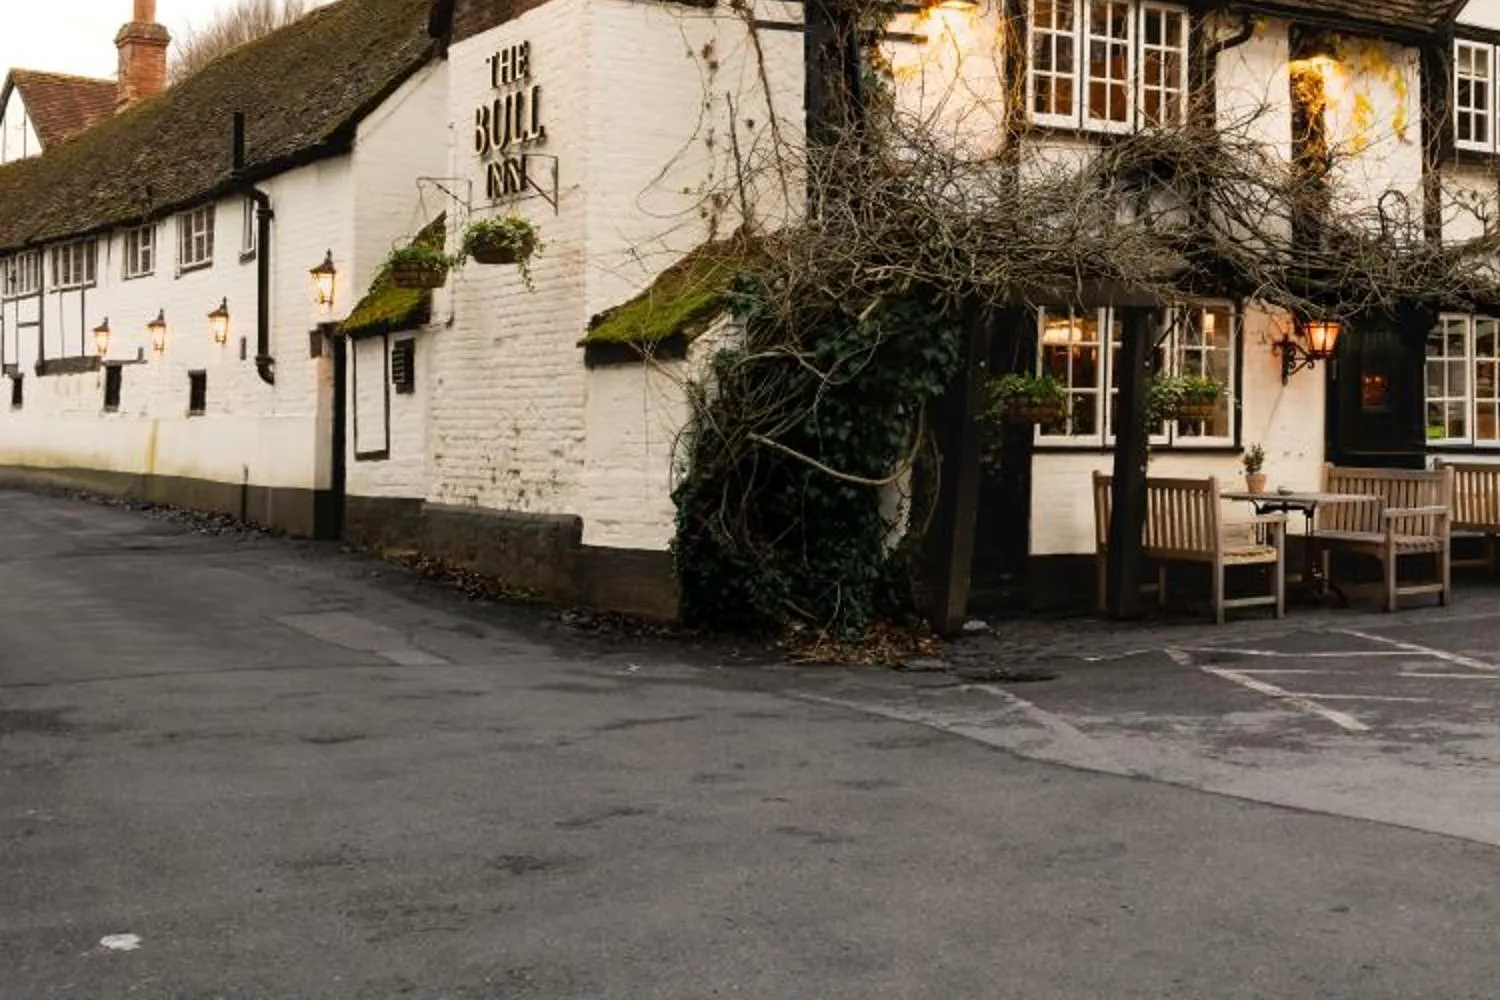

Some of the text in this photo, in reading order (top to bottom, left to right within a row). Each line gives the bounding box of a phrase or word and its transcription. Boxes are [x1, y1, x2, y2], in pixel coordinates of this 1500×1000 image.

[486, 39, 531, 89] THE
[475, 85, 546, 155] BULL
[486, 153, 528, 199] INN
